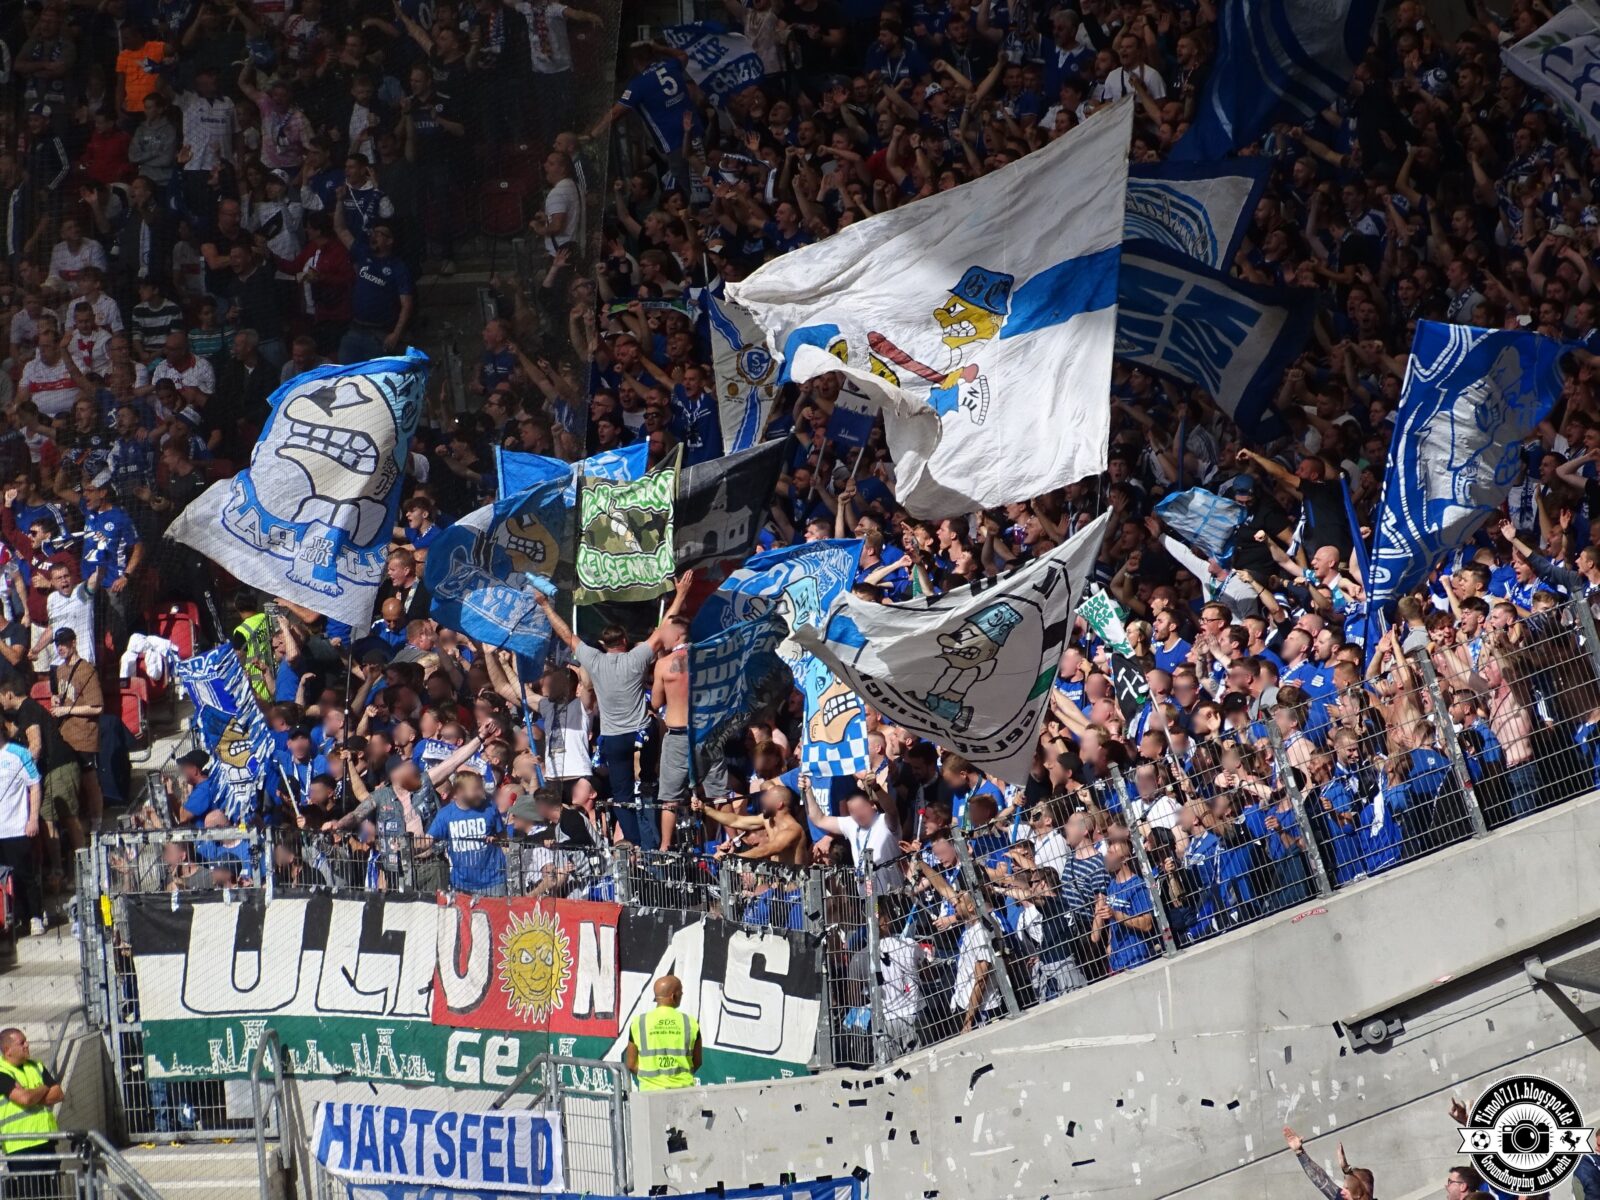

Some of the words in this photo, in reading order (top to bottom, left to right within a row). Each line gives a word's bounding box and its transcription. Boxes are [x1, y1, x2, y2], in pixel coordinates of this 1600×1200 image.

[655, 67, 679, 96] 5
[449, 817, 486, 838] NORD
[319, 1101, 555, 1185] HÄRTSFELD
